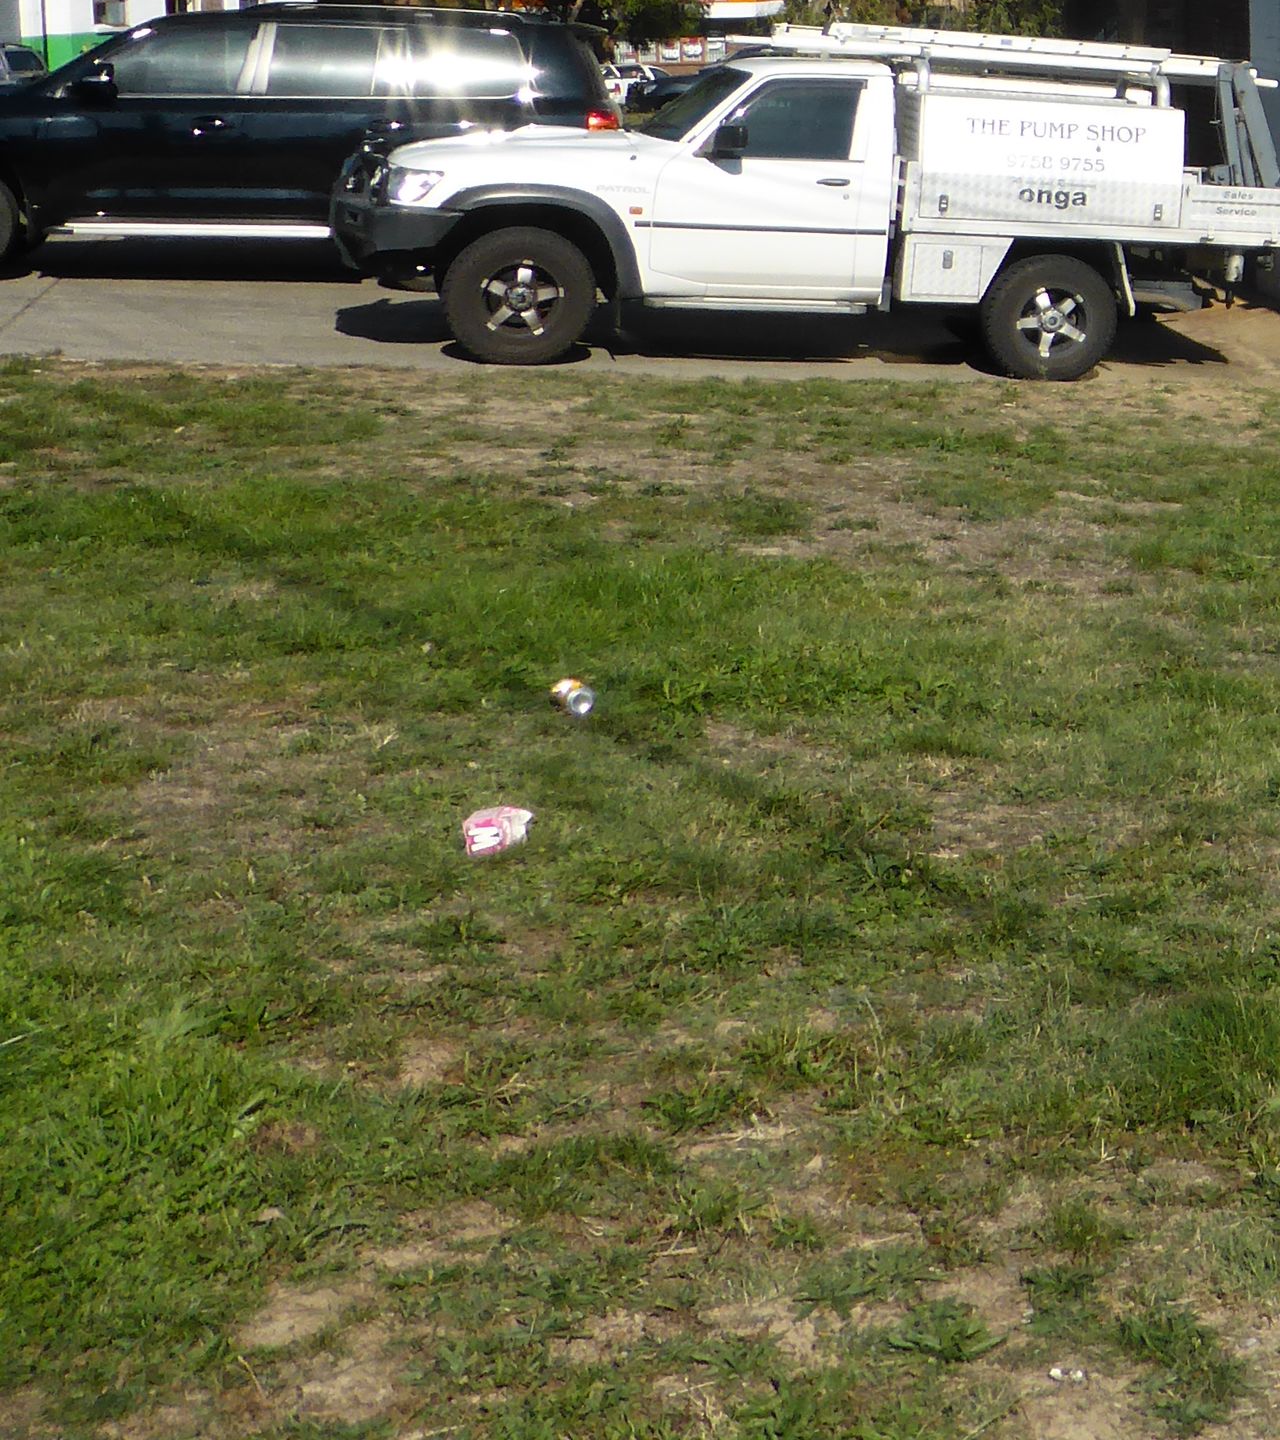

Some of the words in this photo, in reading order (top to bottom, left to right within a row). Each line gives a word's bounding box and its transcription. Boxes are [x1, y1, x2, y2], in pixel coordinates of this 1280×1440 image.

[966, 117, 1010, 136] THE
[1020, 120, 1079, 139] PUMP
[1087, 124, 1146, 143] SHOP
[1060, 157, 1105, 172] 9755
[596, 184, 650, 194] PATROL
[1018, 187, 1087, 210] onga
[1223, 191, 1254, 200] Sales
[1216, 206, 1257, 216] Service
